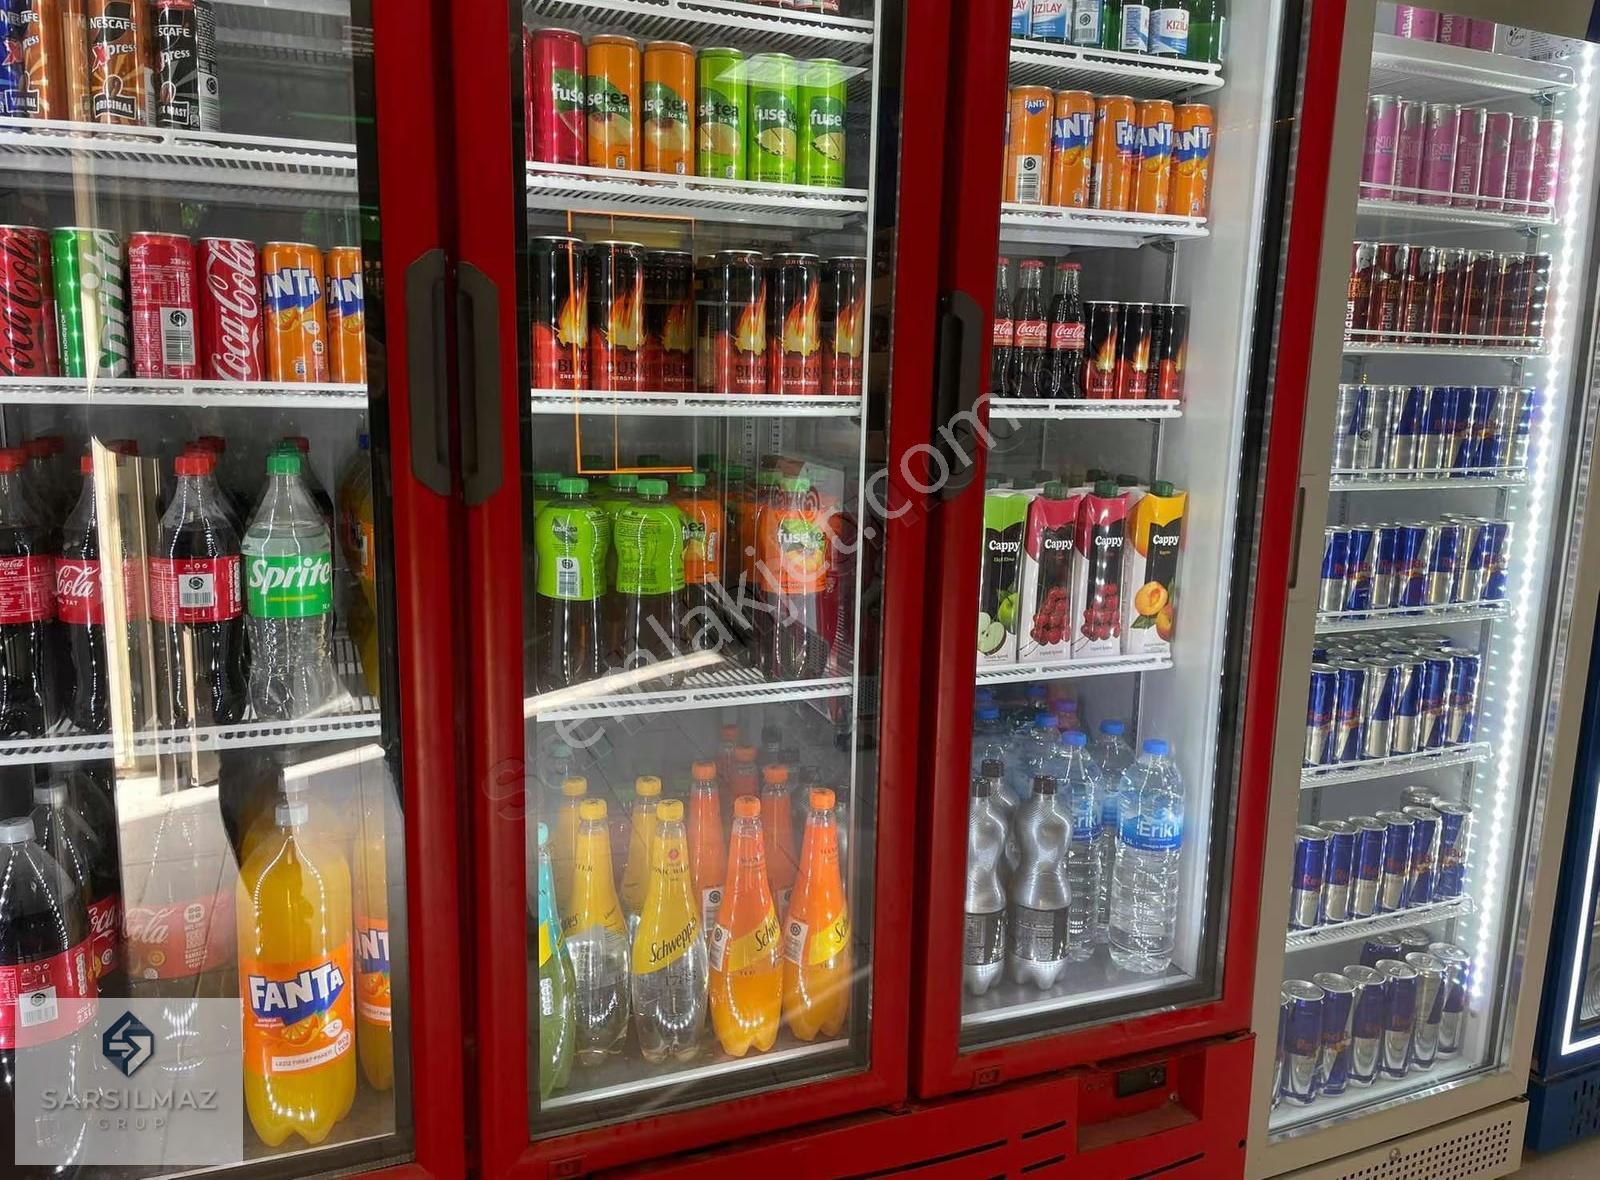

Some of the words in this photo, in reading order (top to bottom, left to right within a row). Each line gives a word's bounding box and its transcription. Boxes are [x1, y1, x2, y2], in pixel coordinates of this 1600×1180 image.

[989, 540, 1020, 552] Cappy
[1044, 538, 1074, 550] Cappy
[1095, 535, 1124, 547] Cappy
[1152, 534, 1179, 546] Cappy
[57, 565, 99, 597] Cola
[250, 557, 330, 595] Sprite
[249, 963, 345, 1012] FANTA
